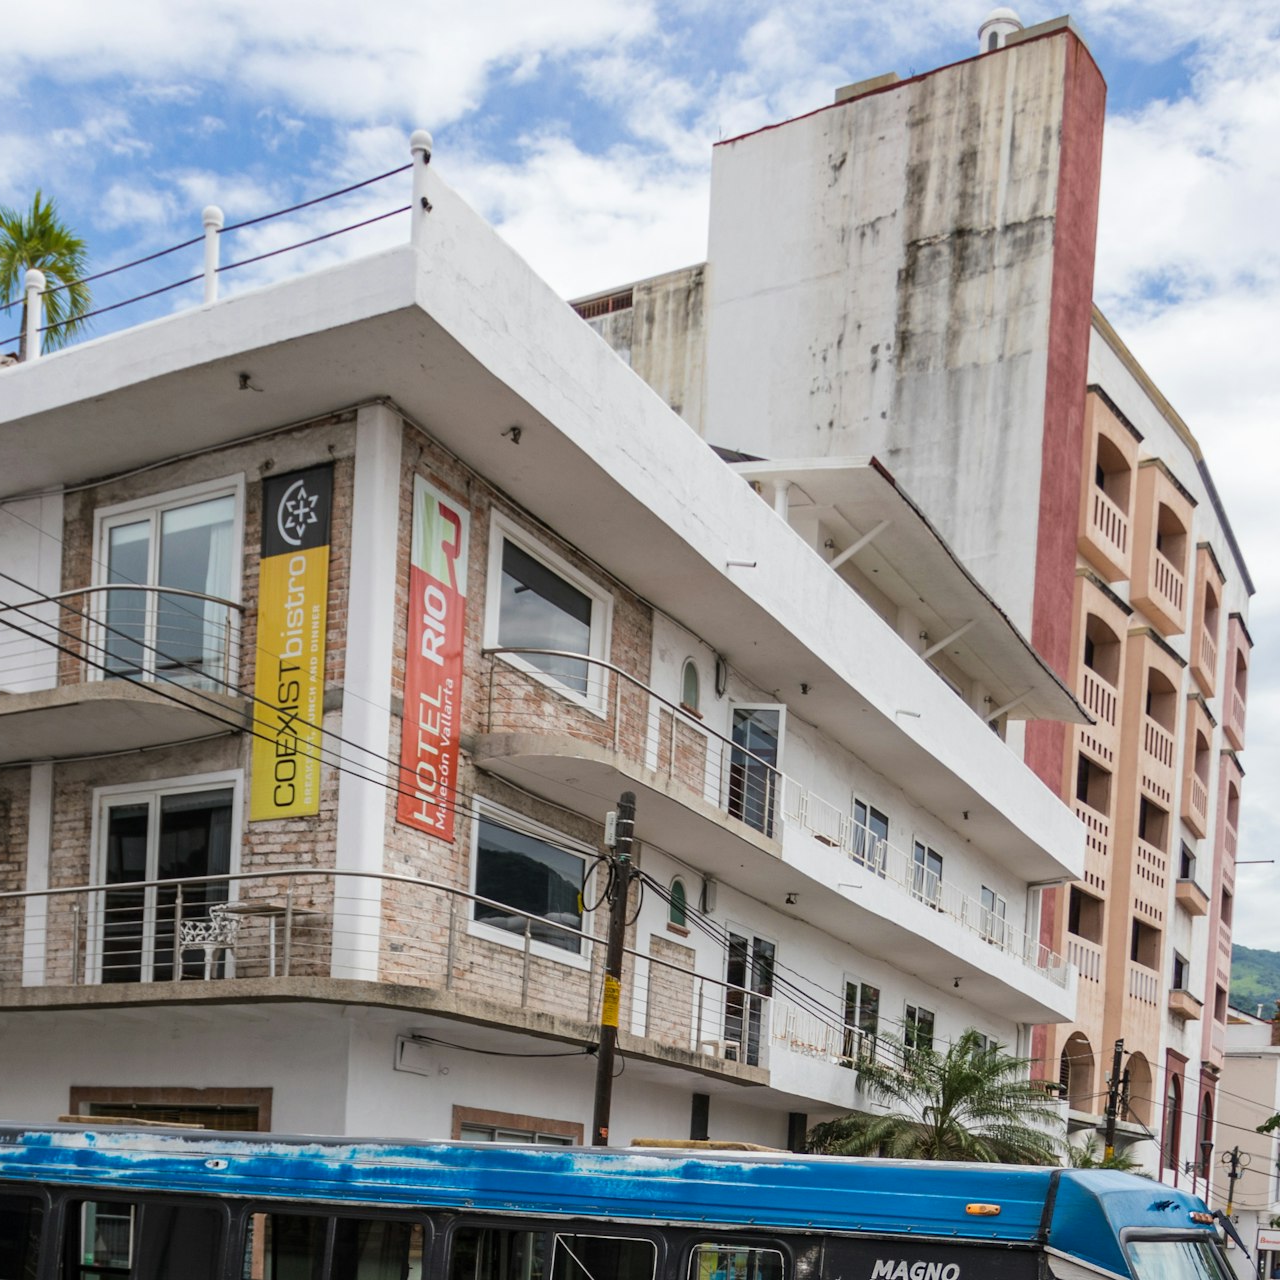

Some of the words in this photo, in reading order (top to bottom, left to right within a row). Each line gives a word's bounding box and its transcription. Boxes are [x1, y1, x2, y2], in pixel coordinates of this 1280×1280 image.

[309, 604, 320, 652] DINNER
[421, 584, 447, 667] RIO
[308, 656, 318, 683] AND
[439, 678, 454, 747] Vallarta
[413, 684, 443, 826] HOTEL
